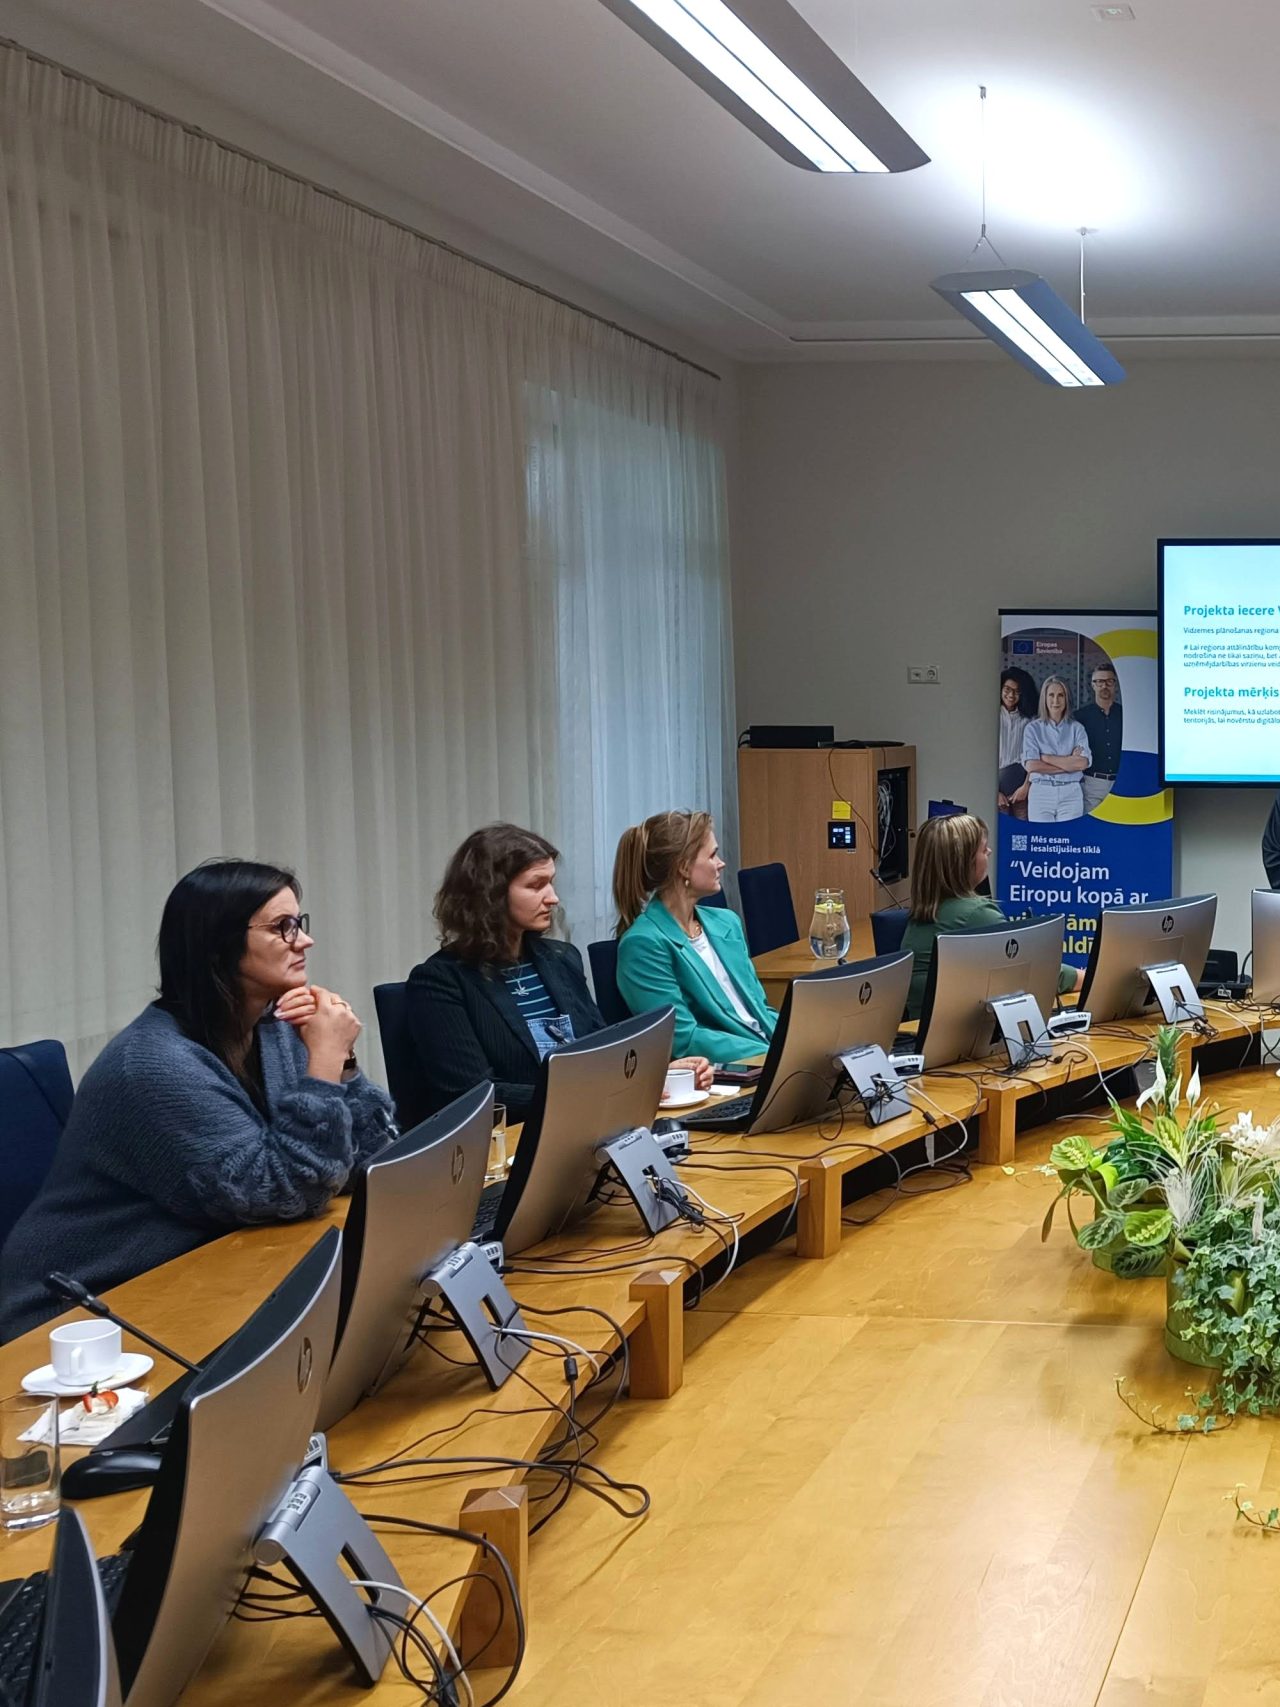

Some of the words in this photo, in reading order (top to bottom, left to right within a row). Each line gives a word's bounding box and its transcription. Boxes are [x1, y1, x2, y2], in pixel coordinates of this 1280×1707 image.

[1183, 604, 1235, 618] Projekta
[1238, 604, 1275, 616] iecere
[1216, 627, 1253, 636] plānošanas
[1183, 686, 1235, 700] Projekta
[1238, 686, 1280, 700] mērķis
[1030, 835, 1047, 844] Mēs
[1010, 860, 1110, 884] “Veidojam
[1010, 885, 1071, 907] Eiropu
[1077, 886, 1124, 909] kopā
[1129, 891, 1149, 905] ar
[1161, 915, 1175, 934] hp
[1005, 938, 1019, 959] hp
